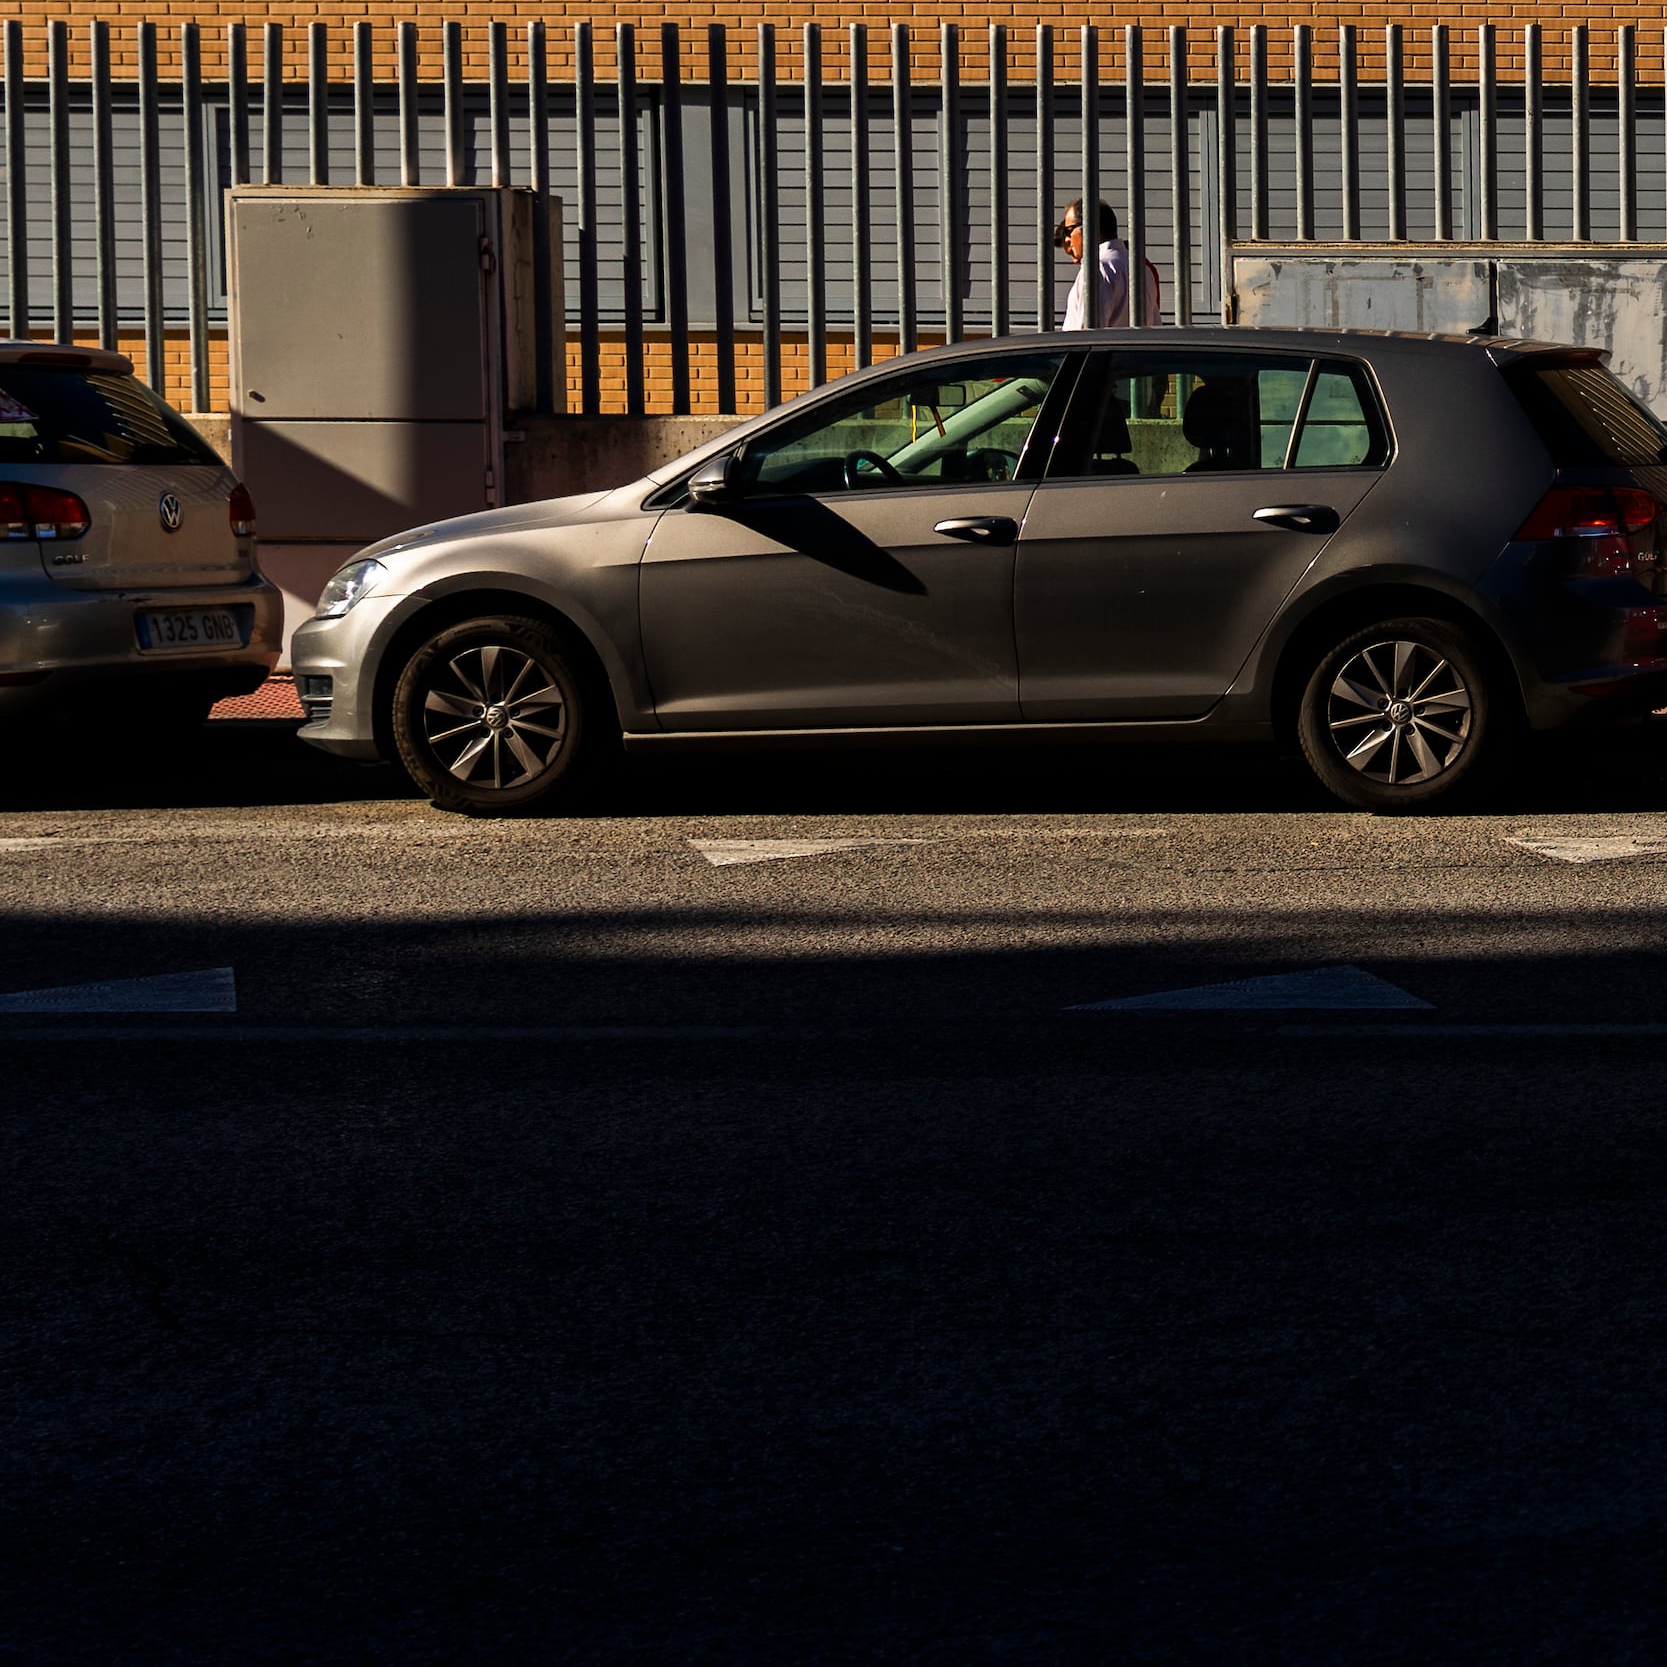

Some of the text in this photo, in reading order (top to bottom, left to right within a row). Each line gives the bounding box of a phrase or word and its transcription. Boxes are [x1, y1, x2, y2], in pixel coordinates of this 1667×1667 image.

[52, 554, 89, 566] GOLF
[152, 611, 236, 644] 1325 GNB
